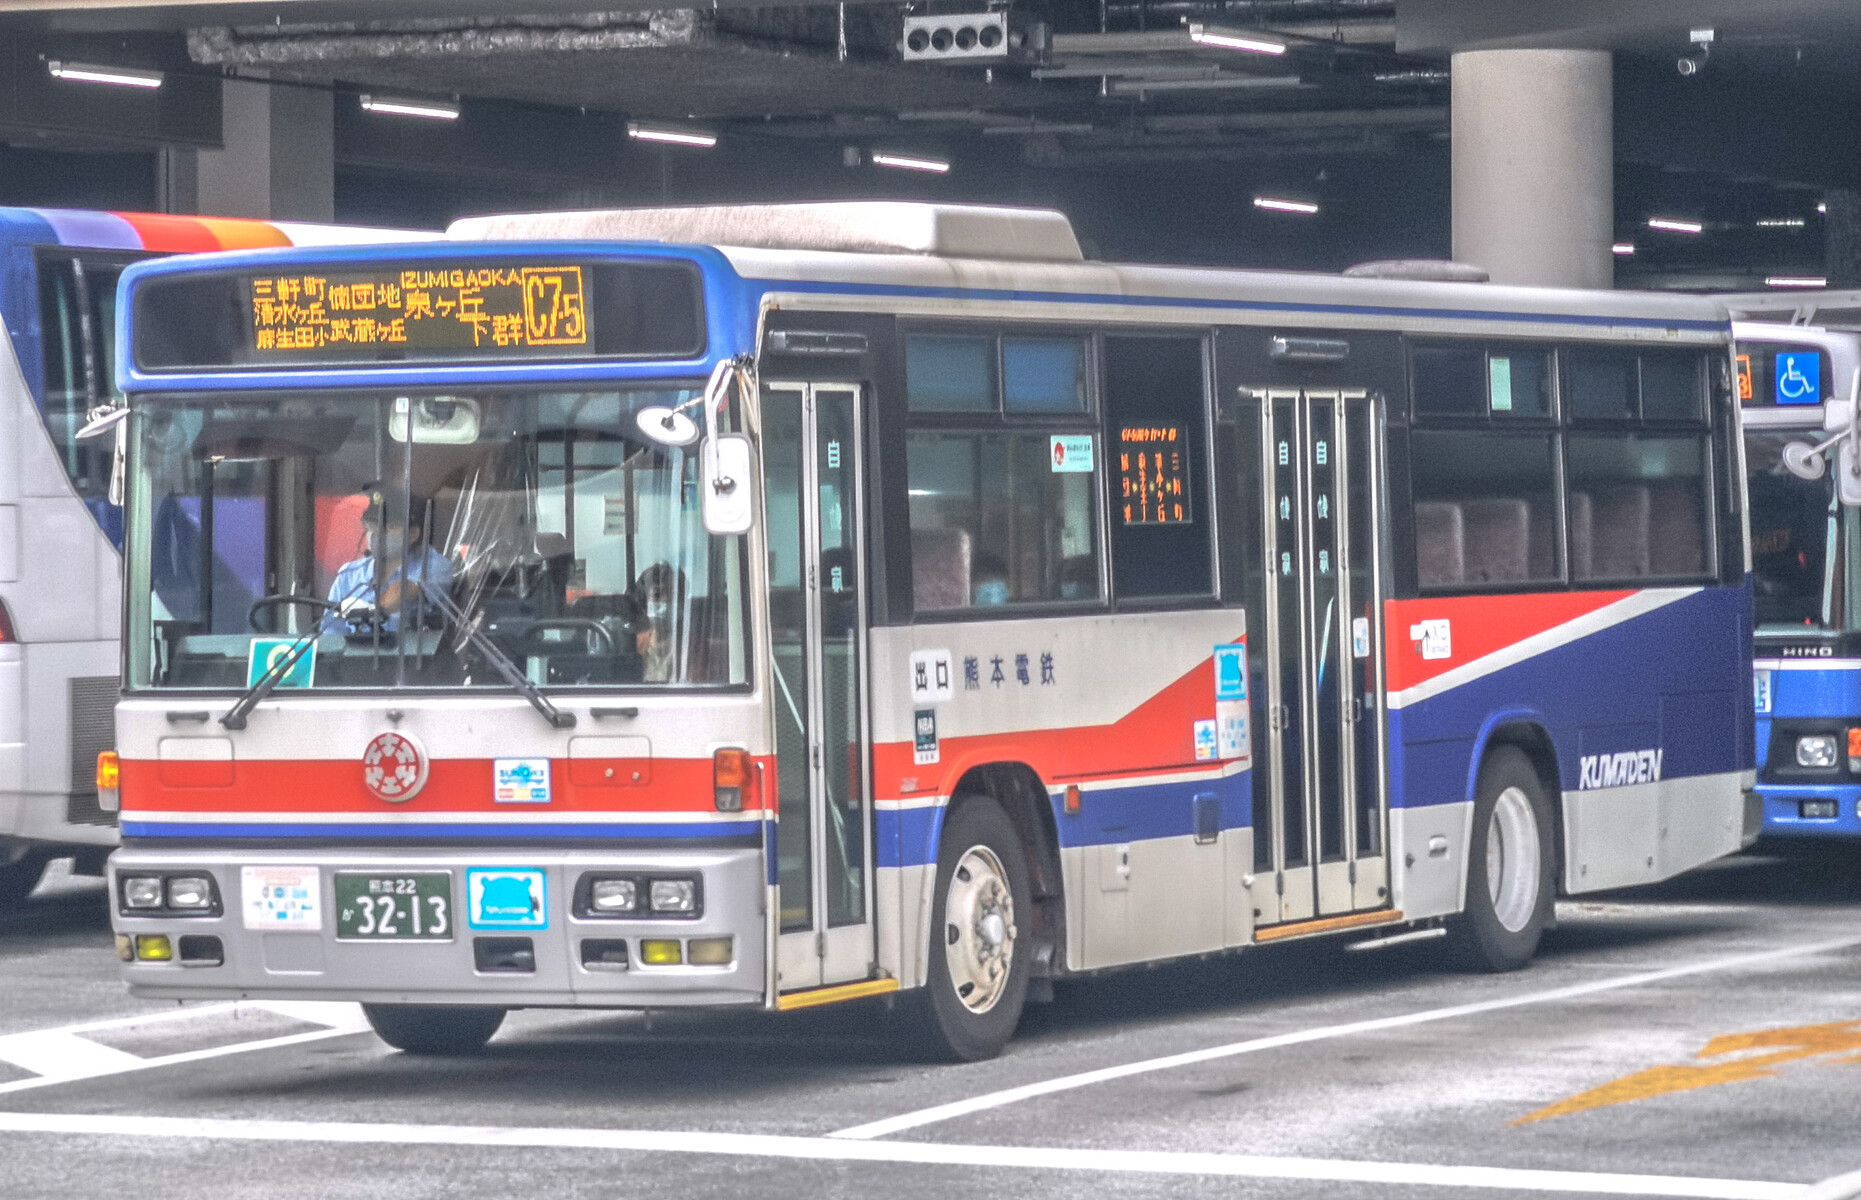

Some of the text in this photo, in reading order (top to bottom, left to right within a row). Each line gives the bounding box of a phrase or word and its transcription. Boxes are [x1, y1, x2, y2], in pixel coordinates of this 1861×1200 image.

[253, 276, 327, 302] 三軒町
[401, 269, 522, 289] IZUMIGAOKA
[1783, 646, 1833, 657] HINO
[915, 660, 949, 691] 出口
[963, 652, 1056, 691] 熊本電鉄
[1579, 748, 1664, 790] KUMADEN
[356, 895, 448, 935] 32-13
